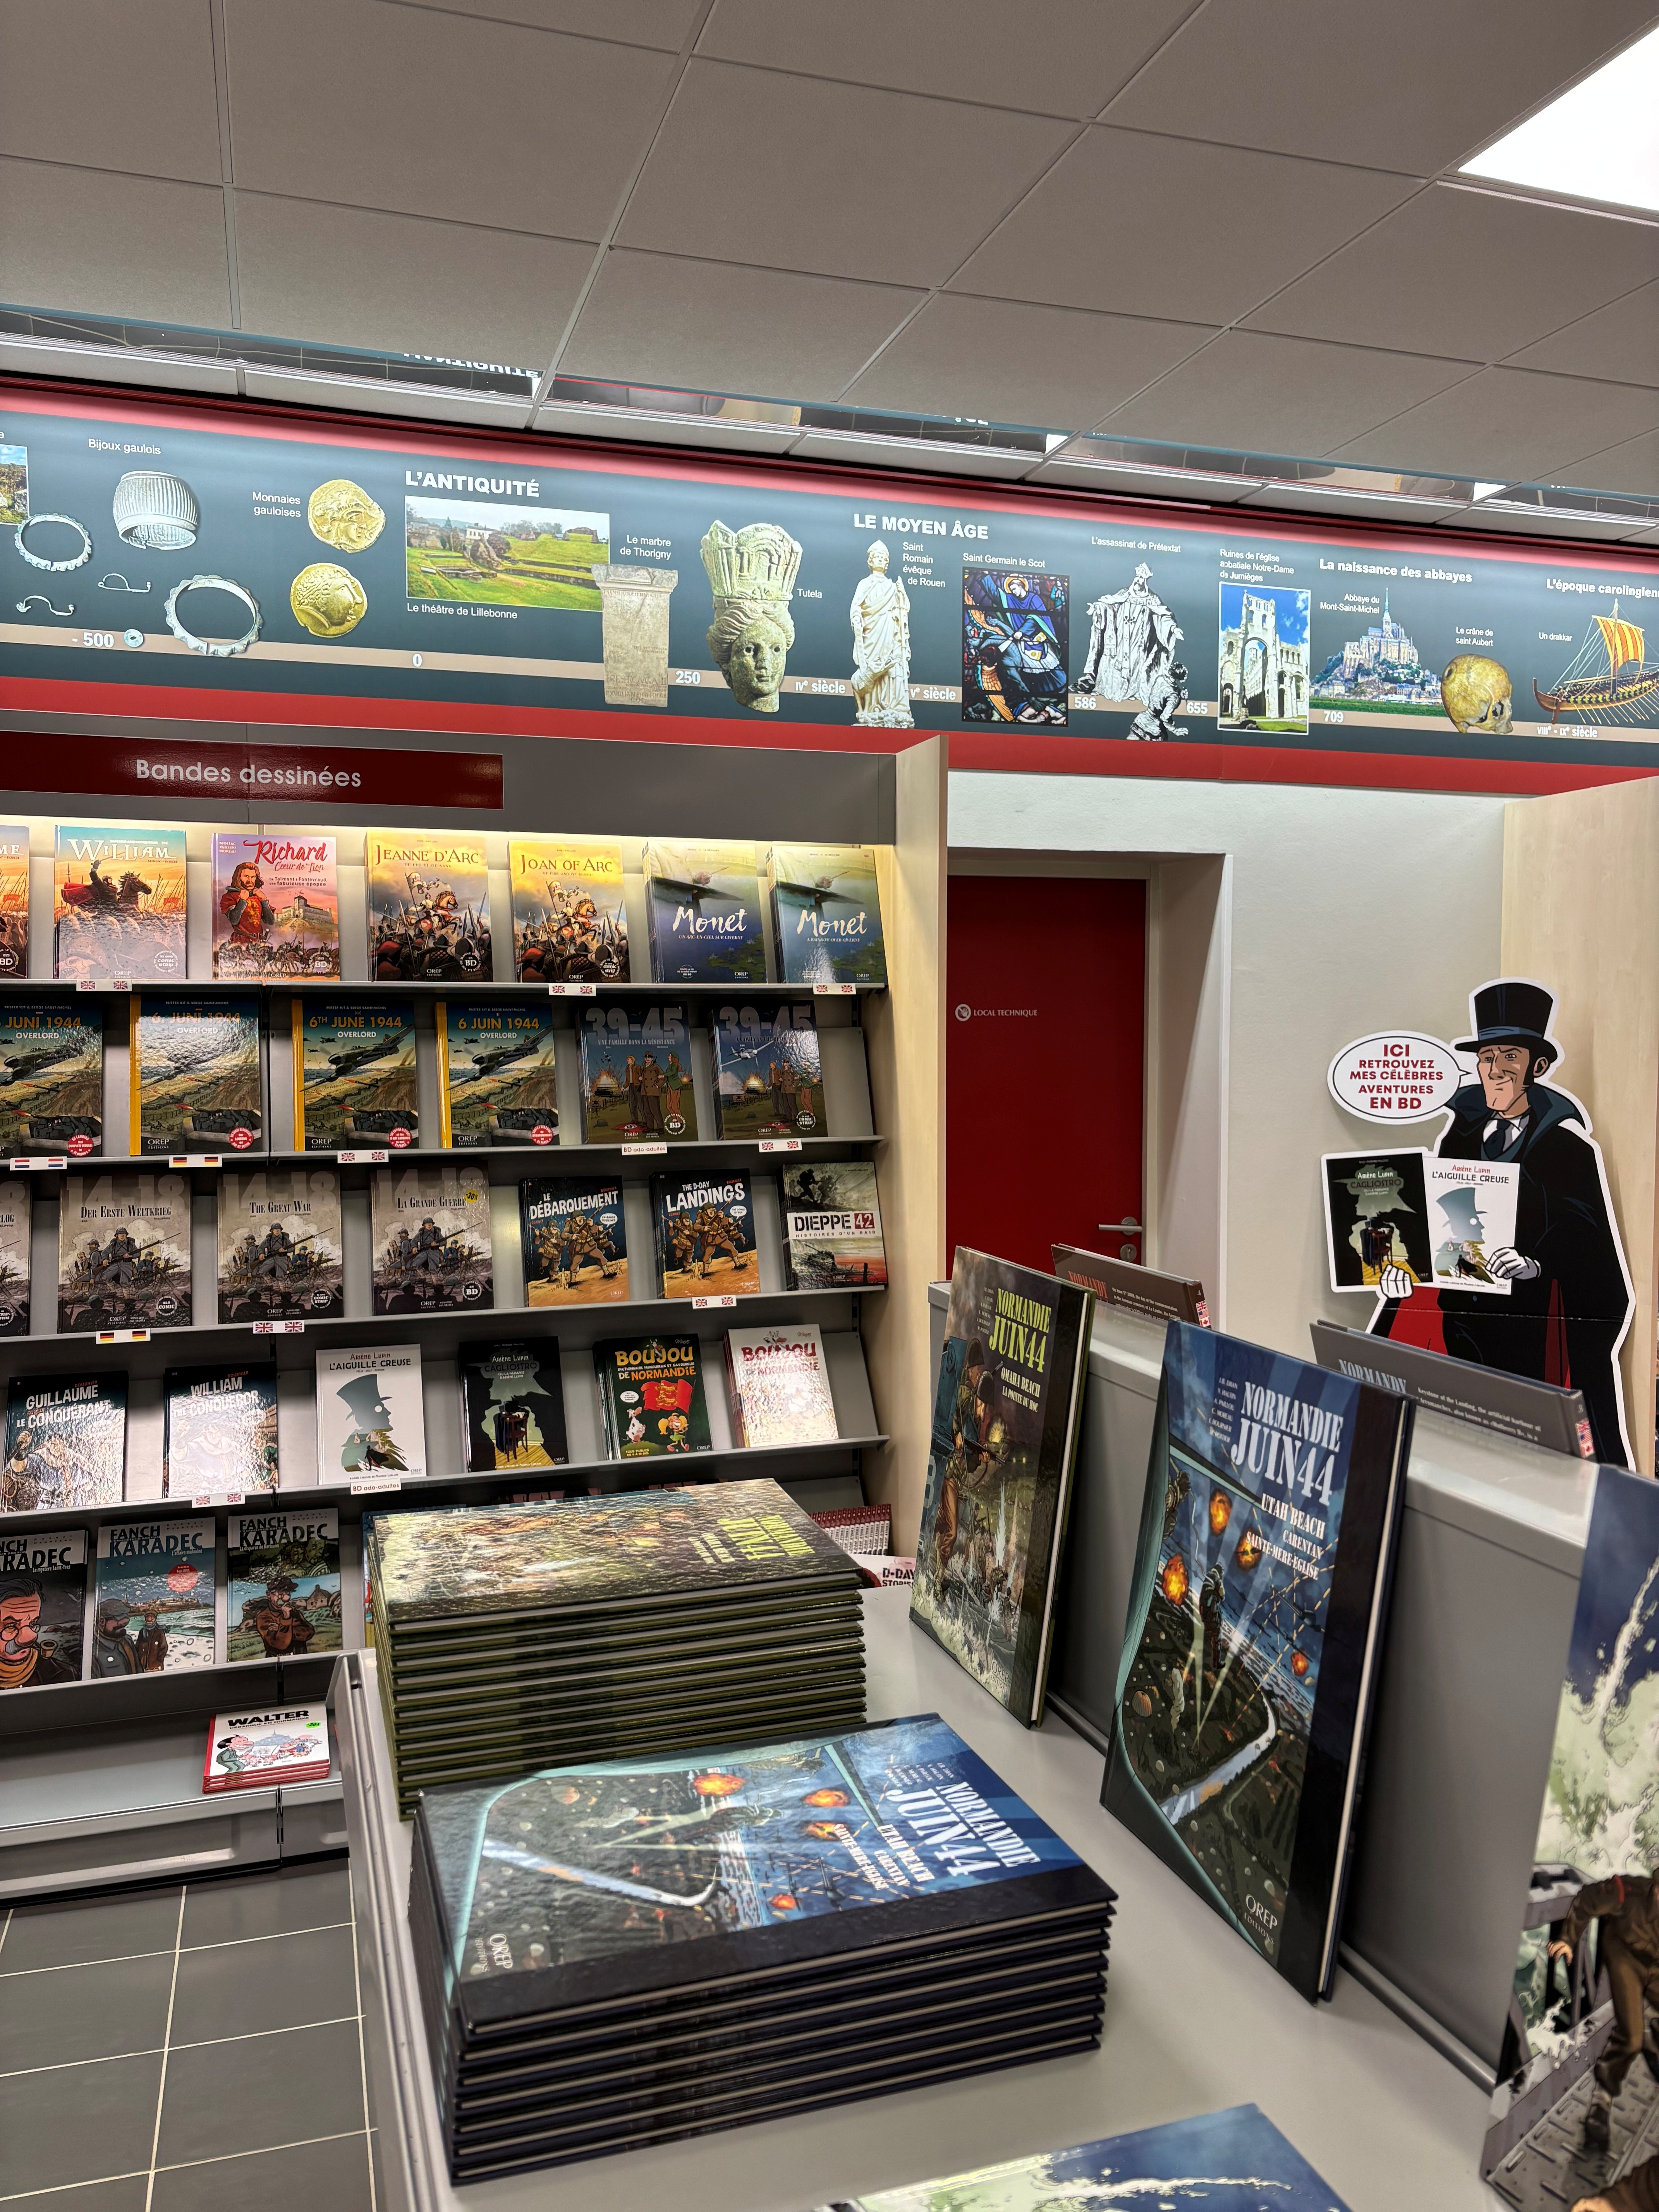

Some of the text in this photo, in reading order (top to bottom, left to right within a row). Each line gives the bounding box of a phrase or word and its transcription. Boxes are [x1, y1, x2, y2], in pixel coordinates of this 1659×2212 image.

[88, 438, 161, 455] Bijoux gaulois
[405, 470, 539, 497] L'ANTIQUITÉ
[252, 492, 301, 505] Monnaies
[254, 506, 301, 518] gauloises
[854, 514, 989, 539] LE MOYEN ÂGE
[627, 535, 671, 547] Le marbre
[903, 542, 924, 552] Saint
[1091, 536, 1181, 553] L'assassinat de Prétextat
[620, 546, 671, 560] de Thorigny
[903, 554, 933, 564] Romain
[1220, 548, 1244, 559] Ruines
[1256, 552, 1280, 563] l'église
[963, 553, 1045, 568] Saint Germain le Scot
[1220, 560, 1295, 574] abbatiale Notre-Dame
[903, 565, 932, 575] évêque
[1220, 570, 1264, 582] de Jumièges
[1319, 558, 1473, 584] La naissance des abbayes
[908, 577, 946, 587] de Rouen
[1546, 578, 1596, 594] L'époque
[797, 588, 823, 598] Tutela
[1344, 593, 1380, 605] Abbaye du
[407, 603, 518, 619] Le théâtre de Lillebonne
[1320, 601, 1379, 614] Mont-Saint-Michel
[1456, 626, 1463, 634] Le
[1465, 626, 1483, 636] crâne
[1539, 632, 1573, 642] Un drakkar
[1456, 636, 1493, 646] saint Aubert
[412, 654, 422, 667] 0
[675, 671, 701, 684] 250
[811, 680, 846, 694] siècle
[923, 687, 956, 701] siècle
[1075, 697, 1096, 709] 586
[1187, 702, 1208, 714] 655
[1324, 710, 1344, 723] 709
[136, 759, 362, 788] Bandes dessinées
[243, 840, 328, 864] Richard
[375, 845, 479, 865] JEANNE D'ARC
[296, 862, 305, 871] de
[306, 862, 325, 873] Lion
[521, 854, 612, 874] JOAN OF ARC
[672, 906, 747, 934] Monet
[797, 909, 867, 936] Monet
[997, 1009, 1037, 1017] TECHNIQUE
[458, 1018, 540, 1029] 6 JUIN 1944
[586, 1007, 685, 1044] 39-45
[337, 1030, 376, 1039] OVERLORD
[1383, 1044, 1410, 1058] ICI
[1359, 1059, 1435, 1069] RETROUVEZ
[1350, 1068, 1443, 1081] MES CÉLÈBRES
[1358, 1085, 1434, 1095] AVENTURES
[1370, 1097, 1422, 1109] EN BD
[1357, 1171, 1376, 1179] ARSÈNE
[1452, 1164, 1491, 1174] ARSÈNE LUPIN
[1432, 1171, 1510, 1184] L'AIGUILLE CREUSE
[693, 1180, 709, 1190] D-DAY
[543, 1193, 551, 1201] LE
[666, 1182, 745, 1212] LANDINGS
[81, 1205, 171, 1218] DER ERSTE WELTKRIEG
[530, 1190, 618, 1219] DÉBARQUEMENT
[794, 1213, 872, 1231] DIEPPE 42
[995, 1288, 1052, 1334] NORMANDIE
[350, 1352, 371, 1360] ARSÈNE
[492, 1355, 512, 1363] ARSÈNE
[615, 1345, 694, 1366] BOUJOU
[329, 1358, 411, 1370] L'AIGUILLE CREUSE
[484, 1362, 538, 1372] CAGLIOSTRO
[1001, 1367, 1041, 1398] OMAHA BEACH
[1338, 1358, 1407, 1394] NORMANDY
[191, 1376, 242, 1396] WILLIAM
[1418, 1387, 1439, 1399] Keystone
[26, 1384, 98, 1410] GUILLAUME
[172, 1390, 259, 1417] THE CONQUEROR
[17, 1399, 111, 1429] LE CONQUÉRANT
[1241, 1381, 1344, 1453] NORMANDIE
[239, 1516, 287, 1530] FANCH
[1262, 1493, 1326, 1541] UTAH BEACH
[110, 1525, 160, 1540] FANCH
[239, 1523, 328, 1547] KARADEC
[109, 1532, 203, 1558] KARADEC
[1282, 1529, 1323, 1560] CARENTAN
[1246, 1530, 1319, 1580] SAINTE-MERE-EGLISE
[228, 1710, 309, 1727] WALTER
[936, 1782, 1041, 1867] NORMANDIE
